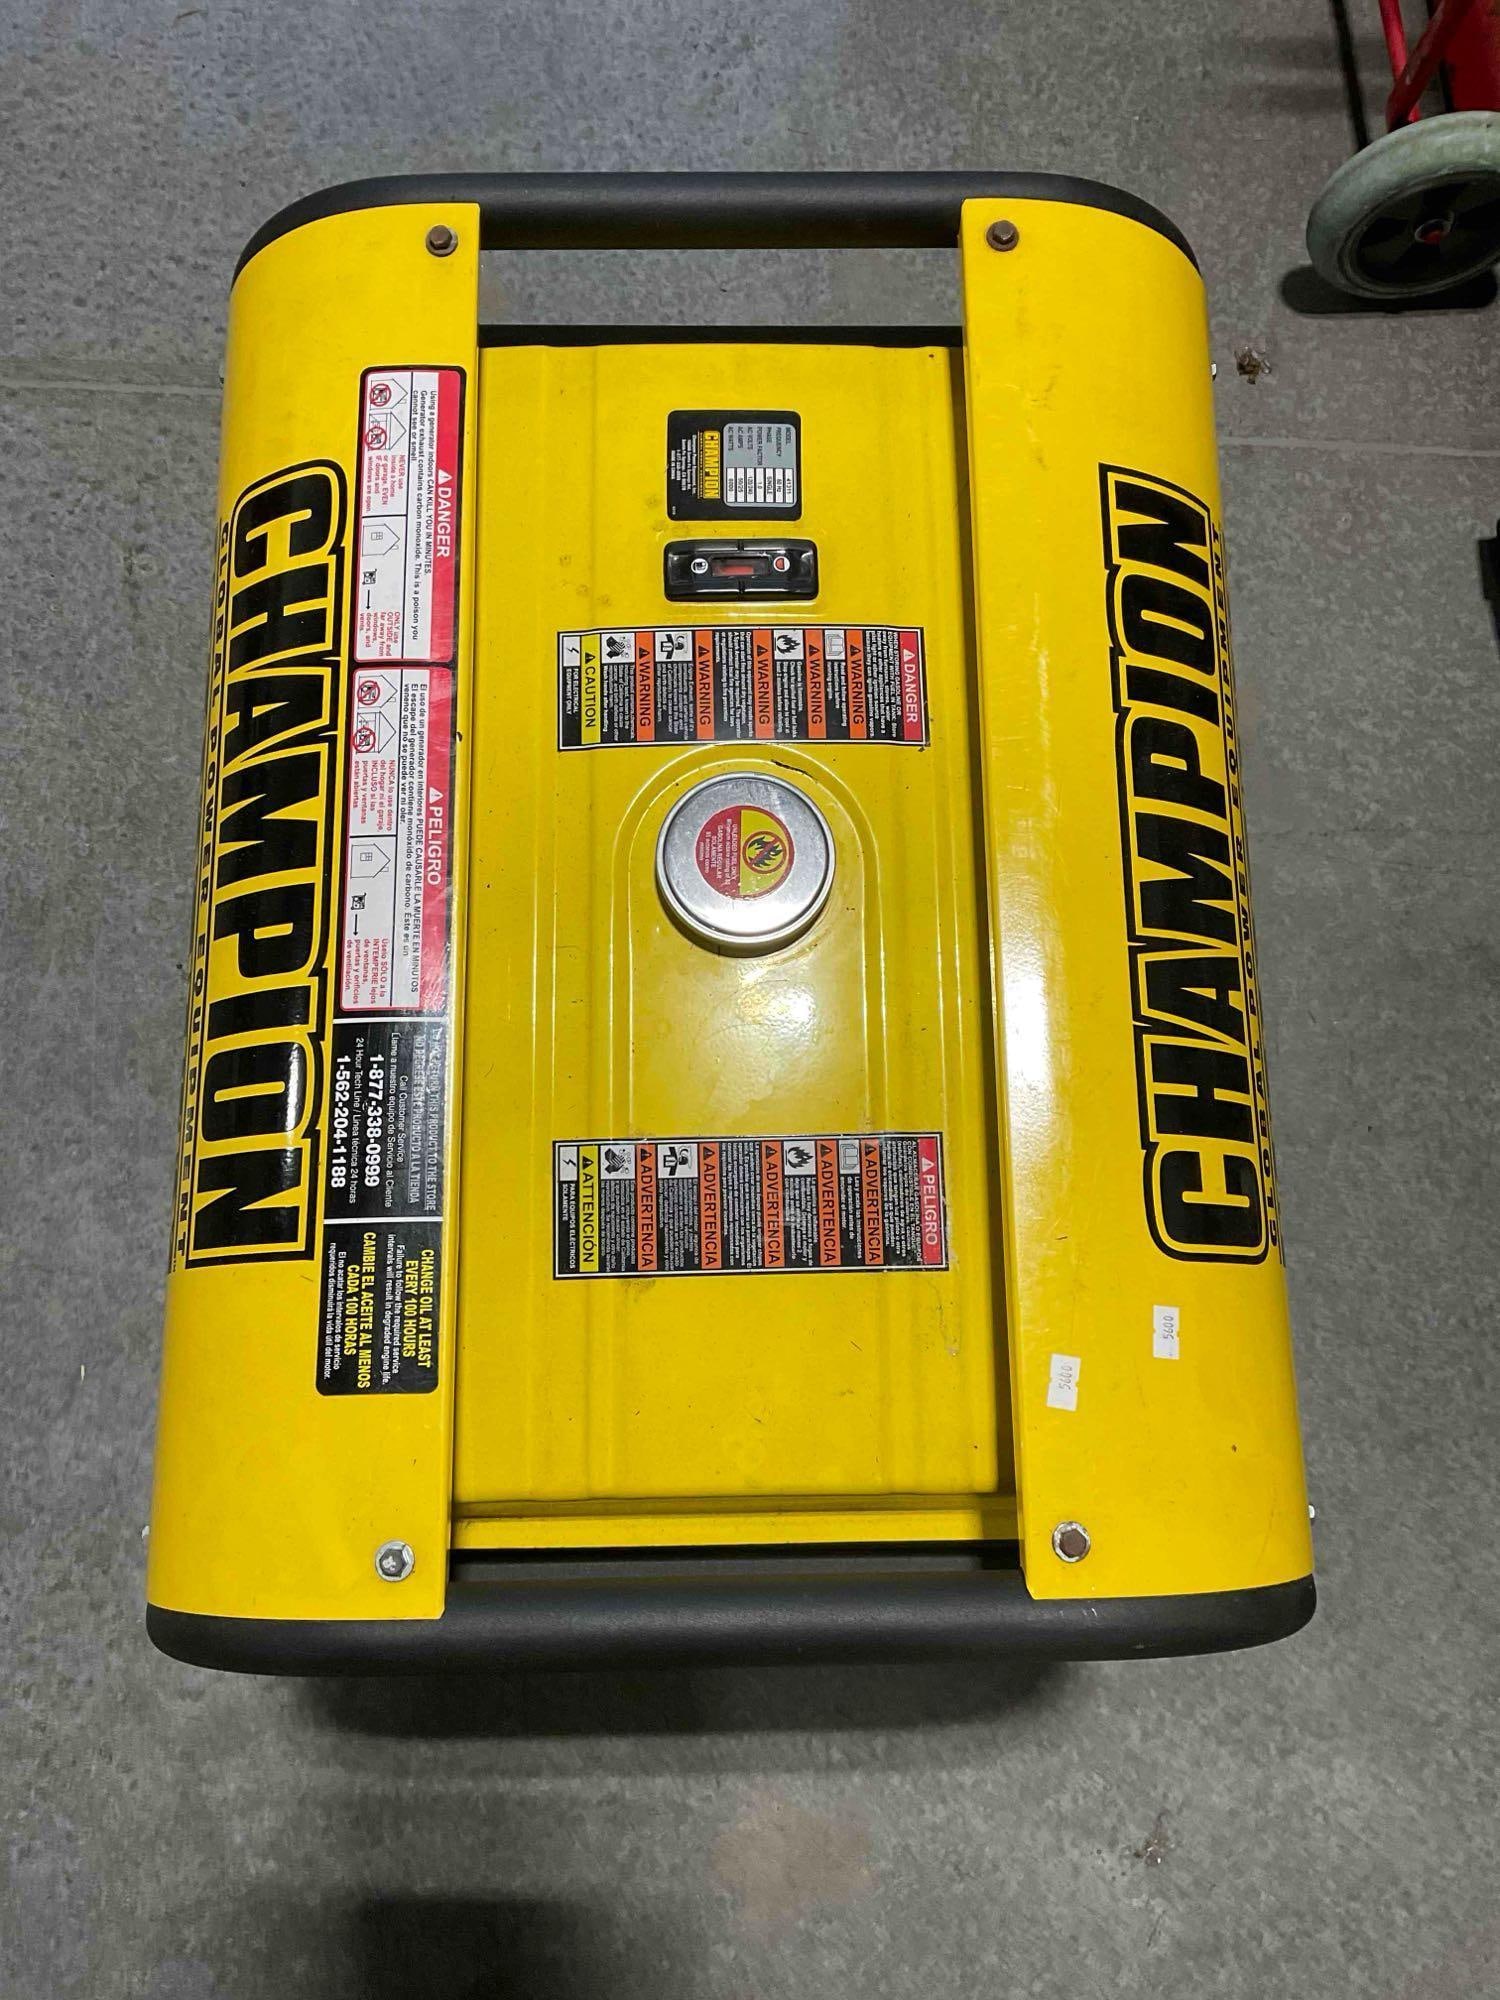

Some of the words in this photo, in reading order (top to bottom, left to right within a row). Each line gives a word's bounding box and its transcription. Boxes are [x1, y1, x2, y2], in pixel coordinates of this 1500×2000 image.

[428, 391, 437, 409] Using
[427, 418, 435, 449] generator
[703, 432, 719, 498] CHAMPION
[436, 488, 451, 557] DANGER
[415, 522, 423, 560] monoxide.
[424, 541, 432, 575] MINUTES.
[211, 522, 229, 707] GLOBAL
[412, 597, 420, 623] poison
[1211, 522, 1238, 807] EQUIPMENT
[585, 666, 596, 728] CAUTION
[639, 662, 650, 727] WARNING
[699, 660, 711, 725] WARNING
[757, 659, 770, 724] WARNING
[809, 659, 822, 724] WARNING
[851, 659, 864, 724] WARNING
[904, 664, 918, 723] DANGER
[419, 708, 426, 717] de
[419, 719, 424, 729] un
[407, 738, 416, 779] generador
[416, 731, 426, 768] generador
[418, 770, 423, 779] en
[201, 728, 217, 903] POWER
[406, 818, 414, 859] monóxido
[427, 806, 442, 885] PELIGRO
[194, 474, 329, 1250] CHAMPION
[406, 861, 412, 871] de
[414, 848, 422, 891] CAUSARLE
[1115, 480, 1262, 1247] CHAMPION
[414, 894, 421, 904] LA
[404, 933, 409, 942] es
[1235, 837, 1256, 1016] POWER
[403, 946, 408, 956] un
[413, 942, 419, 953] EN
[411, 955, 419, 992] MINUTOS
[355, 1049, 363, 1068] Hour
[356, 1038, 363, 1047] 24
[354, 1071, 362, 1089] Tech
[389, 1065, 397, 1093] nuestro
[399, 1076, 408, 1090] Call
[177, 933, 206, 1258] EQUIPMENT
[353, 1091, 361, 1108] Line
[386, 1096, 397, 1122] equipo
[429, 1094, 438, 1111] THIS
[331, 1056, 351, 1188] 1-562-204-1188
[364, 1054, 384, 1187] 1-877-338-0999
[398, 1093, 407, 1131] Customer
[387, 1125, 396, 1135] de
[428, 1114, 437, 1150] PRODUCT
[1253, 1040, 1277, 1246] GLOBAL
[350, 1138, 360, 1166] técnica
[386, 1136, 395, 1168] Servicio
[397, 1133, 406, 1162] Service
[428, 1153, 436, 1163] TO
[350, 1169, 358, 1179] 24
[427, 1166, 436, 1182] THE
[349, 1181, 358, 1203] horas
[384, 1180, 394, 1207] Cliente
[426, 1185, 435, 1210] STORE
[583, 1172, 597, 1262] ATTENCIÓN
[641, 1165, 653, 1267] ADVERTENCIA
[704, 1163, 717, 1265] ADVERTENCIA
[766, 1162, 780, 1264] ADVERTENCIA
[821, 1160, 836, 1262] ADVERTENCIA
[866, 1159, 881, 1262] ADVERTENCIA
[923, 1175, 937, 1245] PELIGRO
[362, 1232, 376, 1273] CAMBIE
[387, 1234, 396, 1264] intervals
[396, 1245, 405, 1269] Failure
[346, 1265, 360, 1295] CADA
[362, 1275, 374, 1289] EL
[386, 1266, 394, 1278] will
[405, 1260, 418, 1296] EVERY
[420, 1249, 434, 1295] CHANGE
[385, 1279, 394, 1300] result
[395, 1279, 403, 1301] follow
[345, 1297, 358, 1315] 100
[360, 1291, 374, 1330] ACEITE
[404, 1298, 417, 1316] 100
[419, 1297, 433, 1315] OIL
[343, 1317, 357, 1355] HORAS
[359, 1332, 372, 1347] AL
[382, 1310, 393, 1344] degraded
[391, 1316, 402, 1346] required
[402, 1318, 416, 1357] HOURS
[419, 1317, 432, 1331] AT
[1162, 1315, 1174, 1340] 5600
[381, 1345, 391, 1370] engine
[392, 1347, 401, 1374] service
[418, 1333, 431, 1368] LEAST
[357, 1349, 372, 1388] MENOS
[382, 1371, 390, 1385] life.
